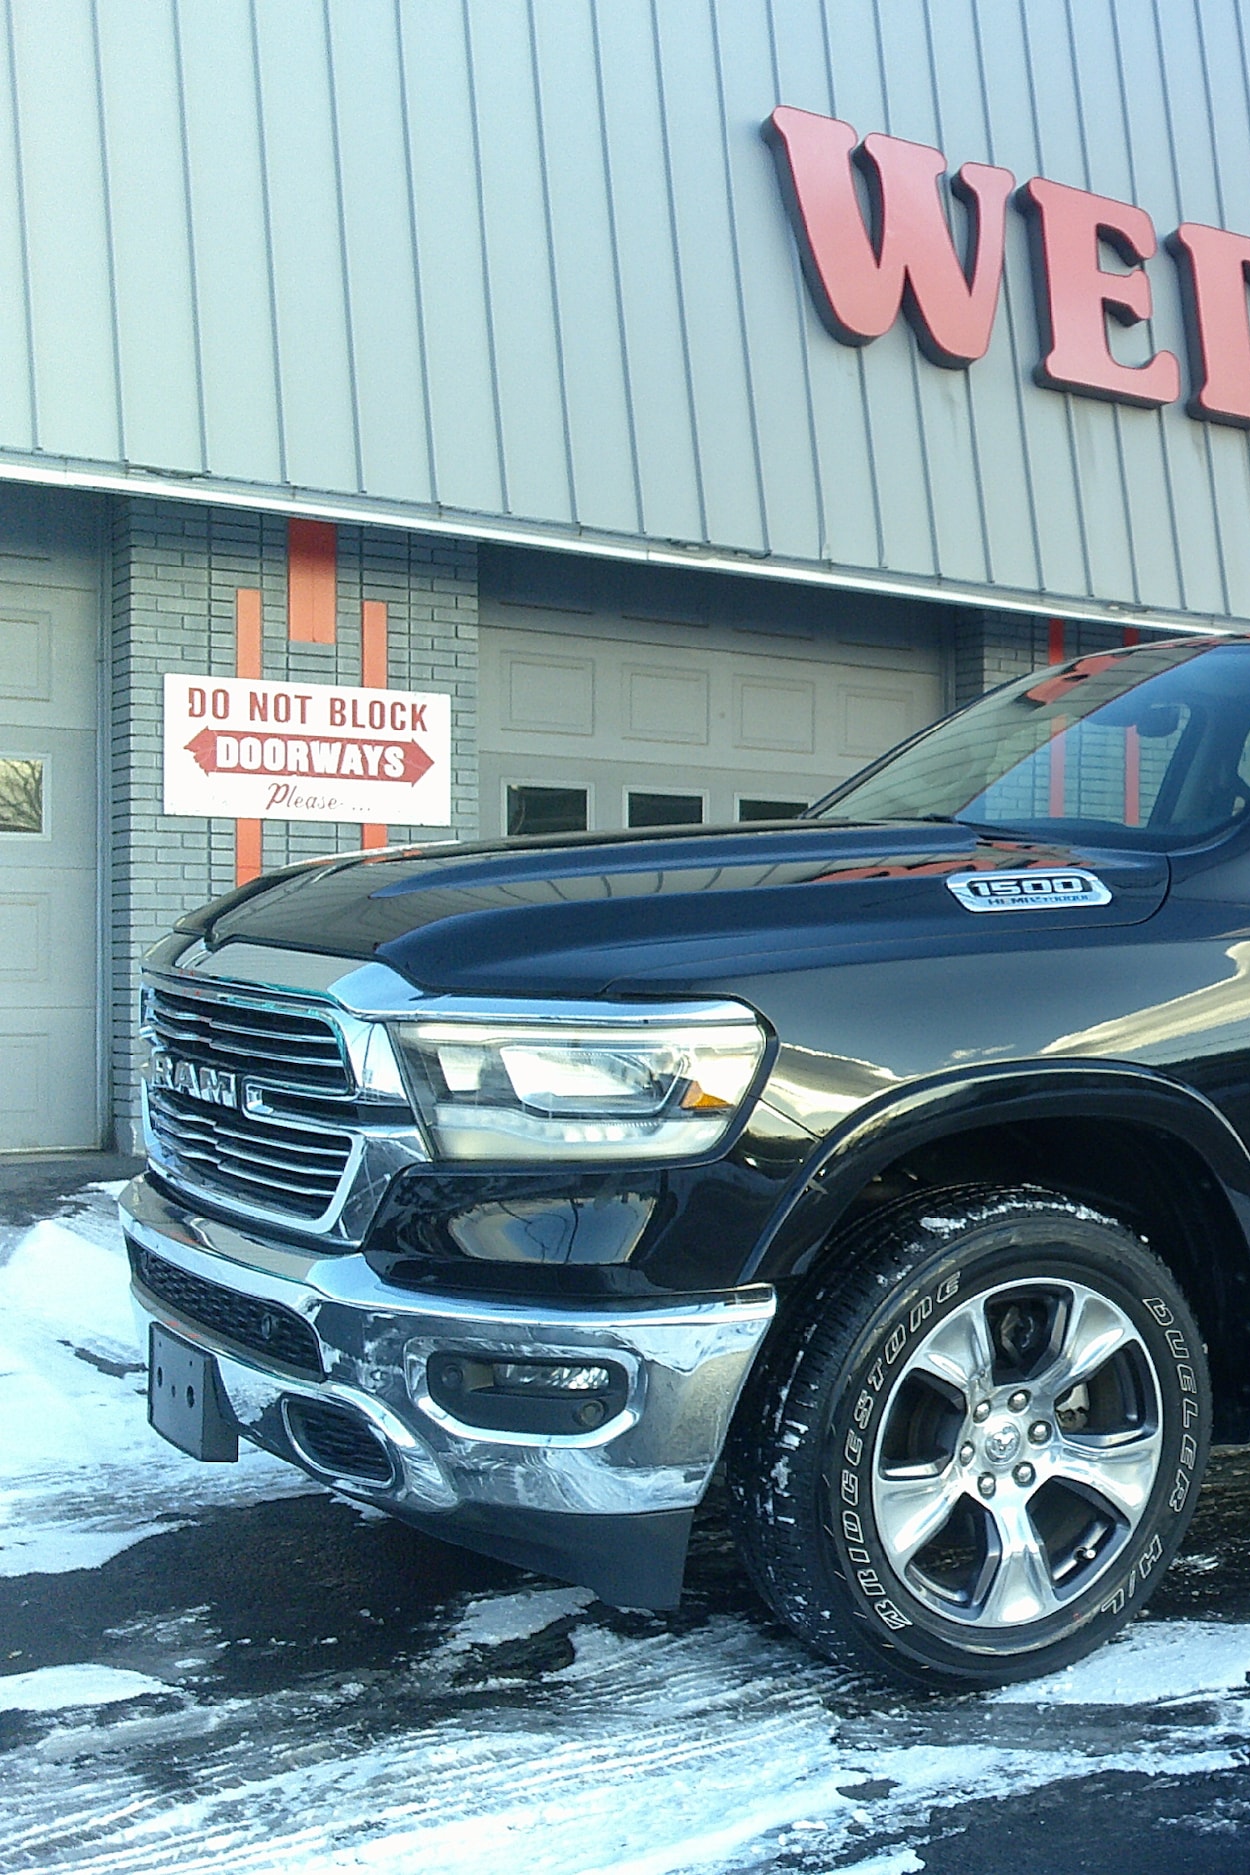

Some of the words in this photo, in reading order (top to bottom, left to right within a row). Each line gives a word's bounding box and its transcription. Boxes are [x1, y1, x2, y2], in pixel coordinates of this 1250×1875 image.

[188, 687, 230, 720] DO
[249, 691, 313, 725] NOT
[329, 697, 428, 732] BLOCK
[215, 735, 406, 778] DOORWAYS
[971, 877, 1083, 897] 1500
[152, 1055, 238, 1109] RAM
[1143, 1296, 1199, 1514] DUELER
[839, 1270, 963, 1631] BRIDGESTONE
